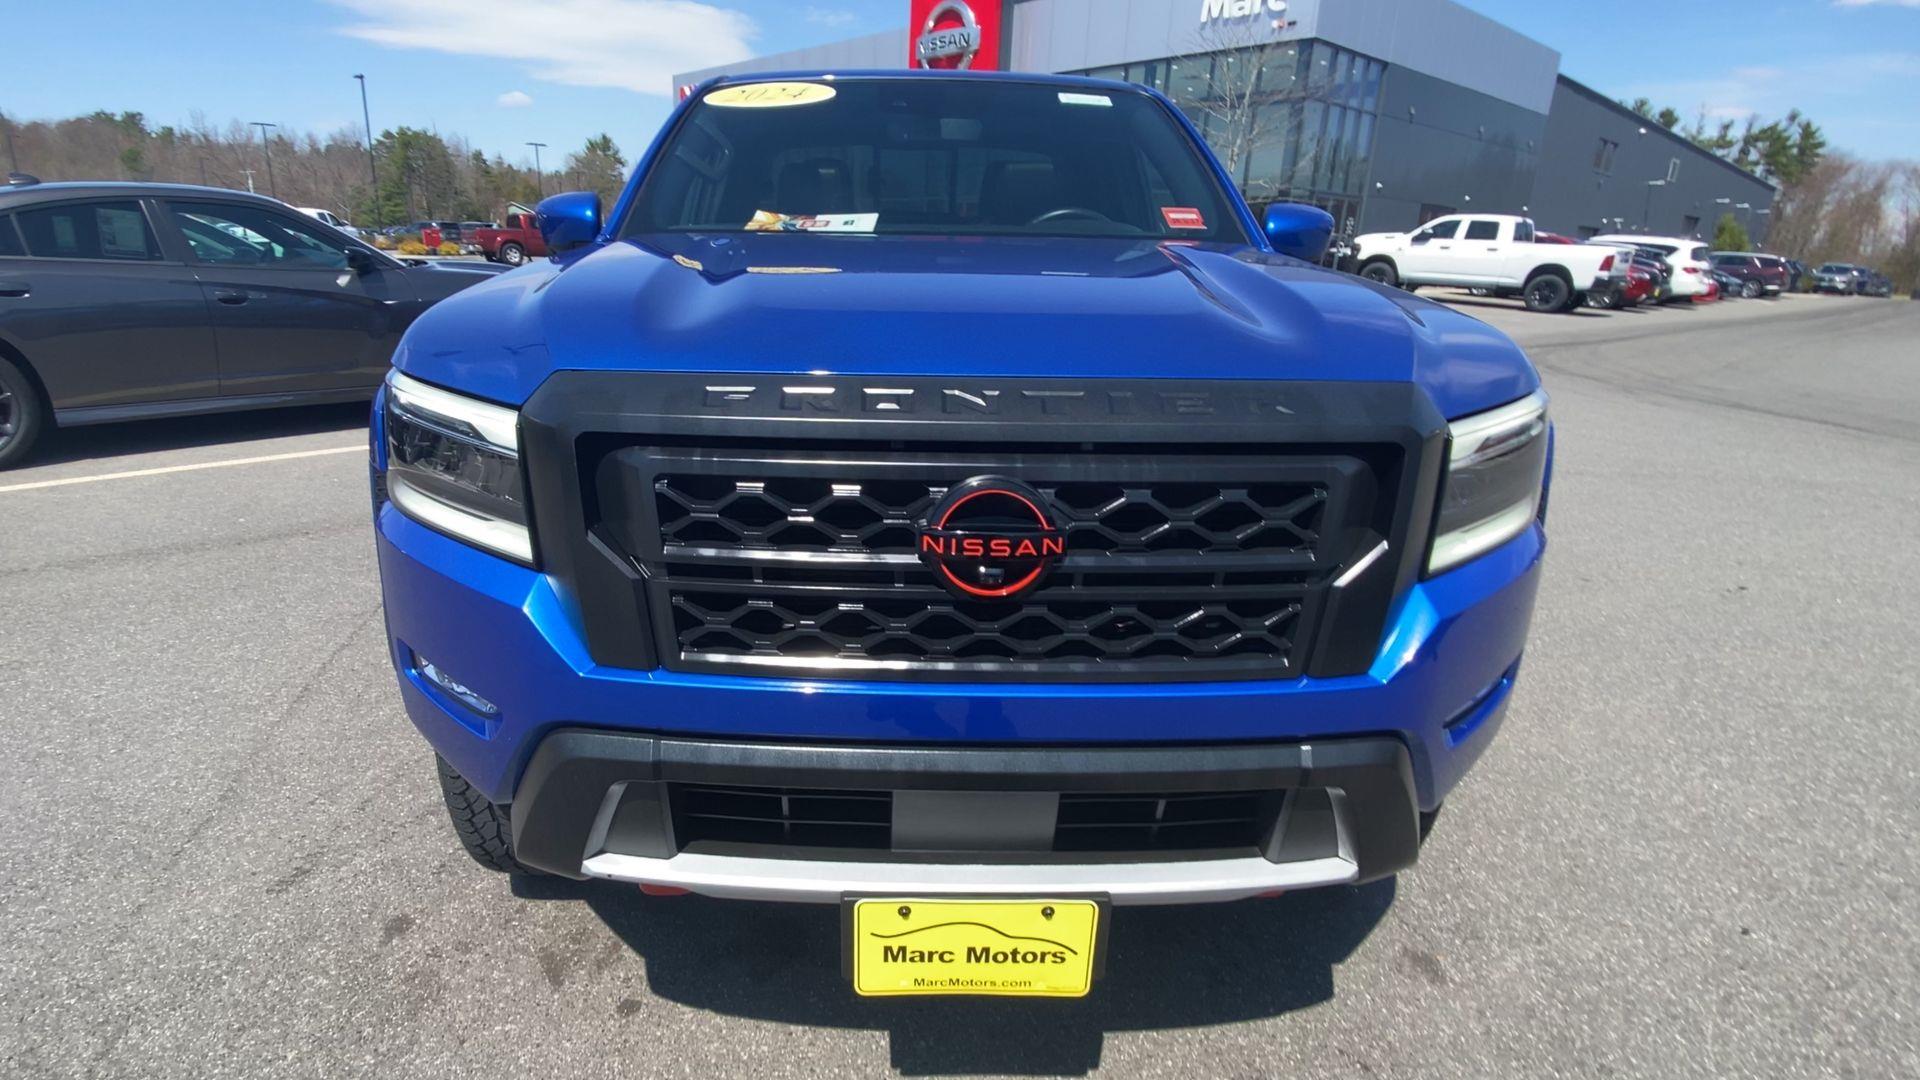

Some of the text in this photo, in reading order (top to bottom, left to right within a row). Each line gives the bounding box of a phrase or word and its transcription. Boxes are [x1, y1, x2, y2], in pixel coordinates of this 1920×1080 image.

[921, 534, 1064, 558] NISSAN
[882, 945, 1068, 965] Marc Motors
[912, 976, 1033, 989] MarcMotors.com
